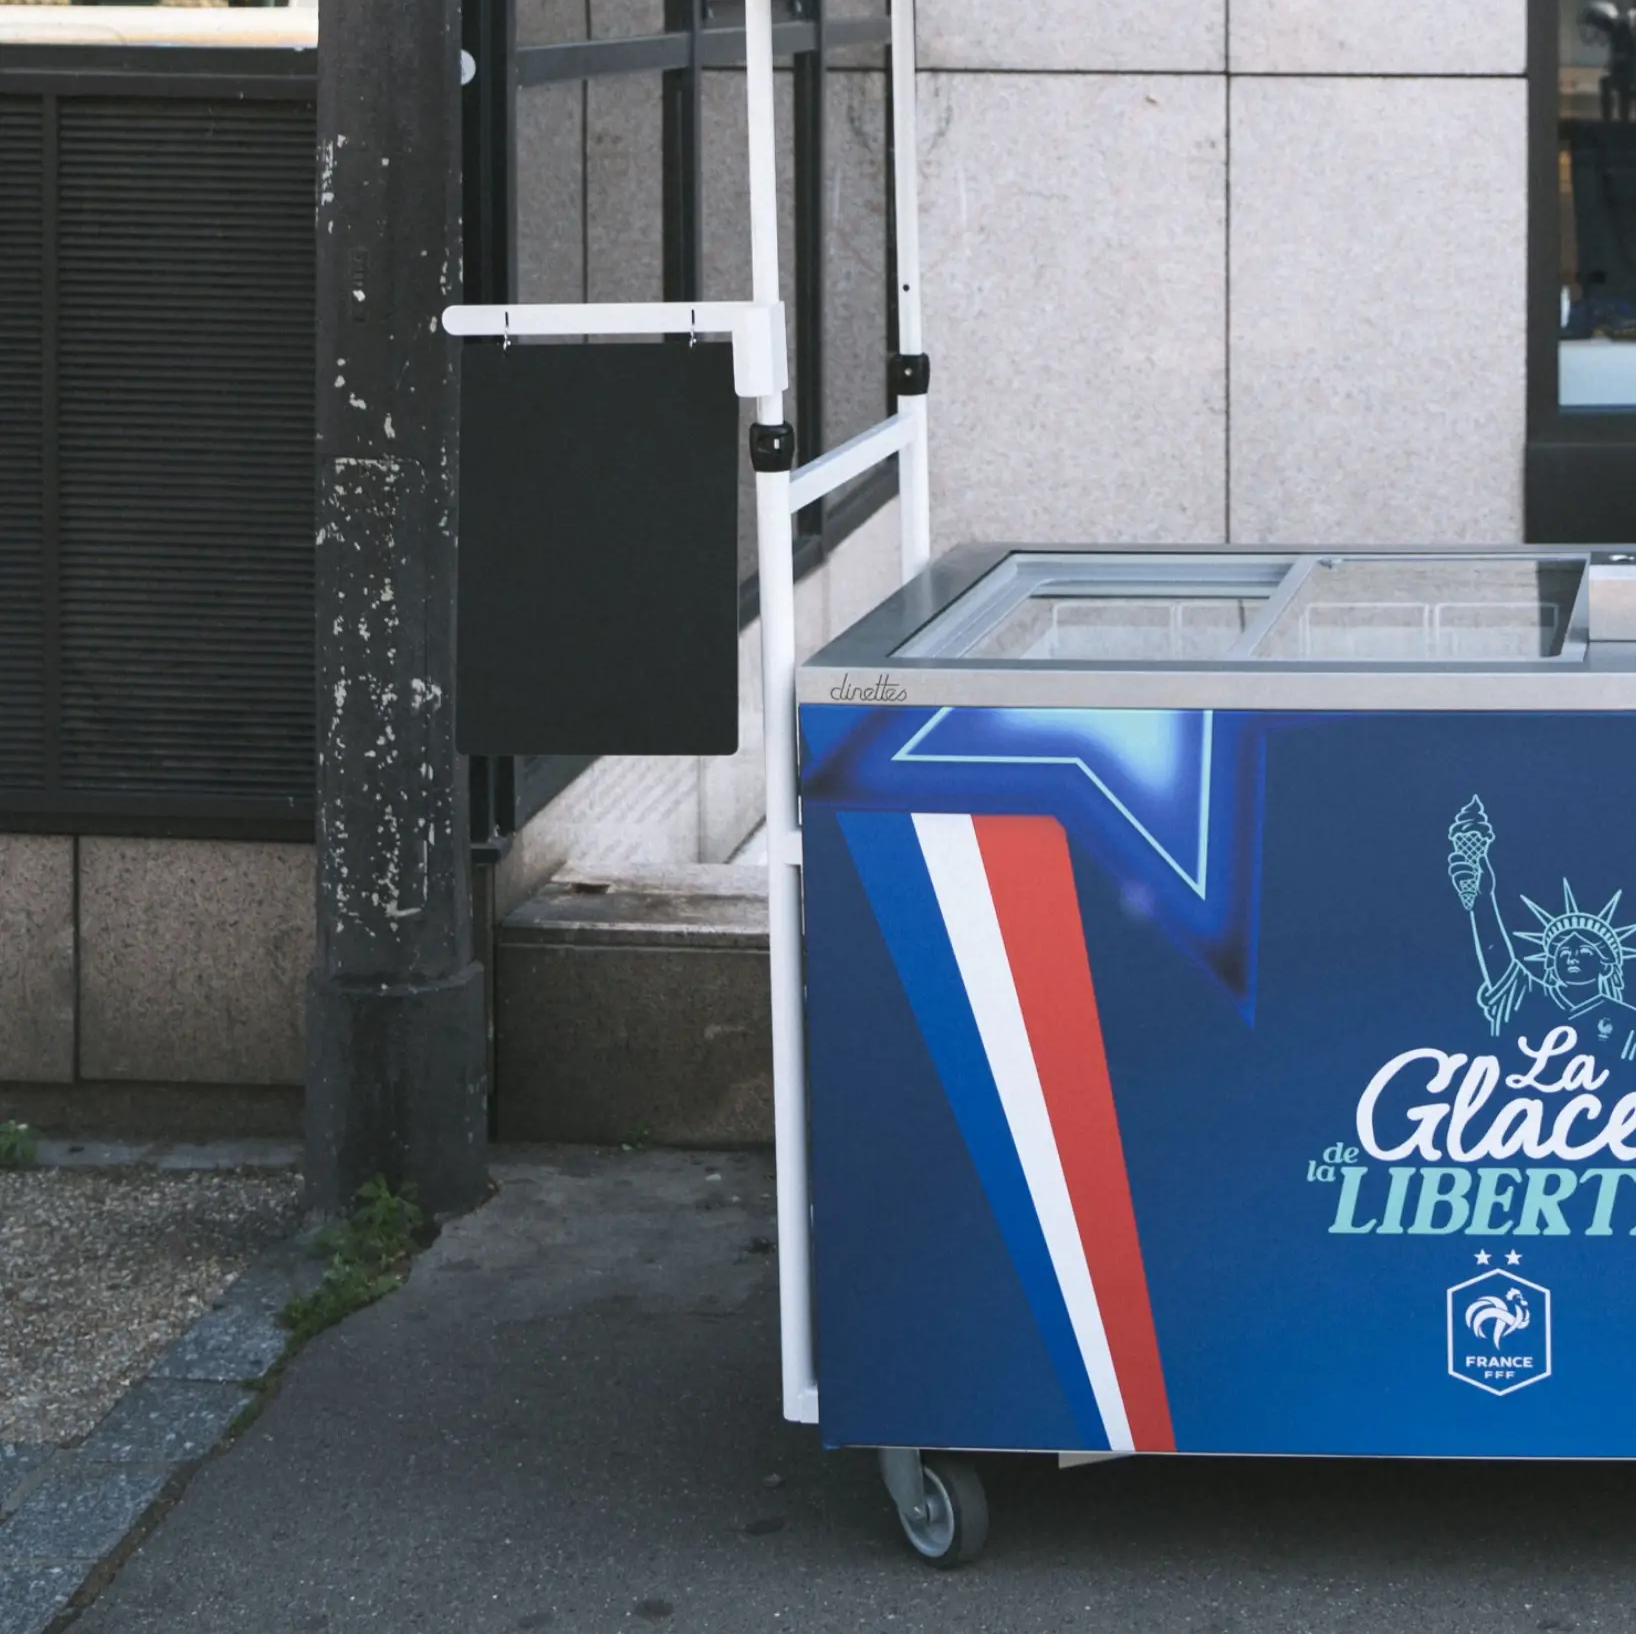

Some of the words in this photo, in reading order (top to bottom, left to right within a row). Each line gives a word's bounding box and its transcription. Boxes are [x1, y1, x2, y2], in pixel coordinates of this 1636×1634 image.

[830, 673, 907, 702] dinettes
[1506, 1025, 1610, 1093] La
[1323, 1142, 1360, 1163] de
[1306, 1161, 1337, 1182] la
[1465, 1356, 1534, 1368] FRANCE
[1484, 1370, 1515, 1379] FFF
